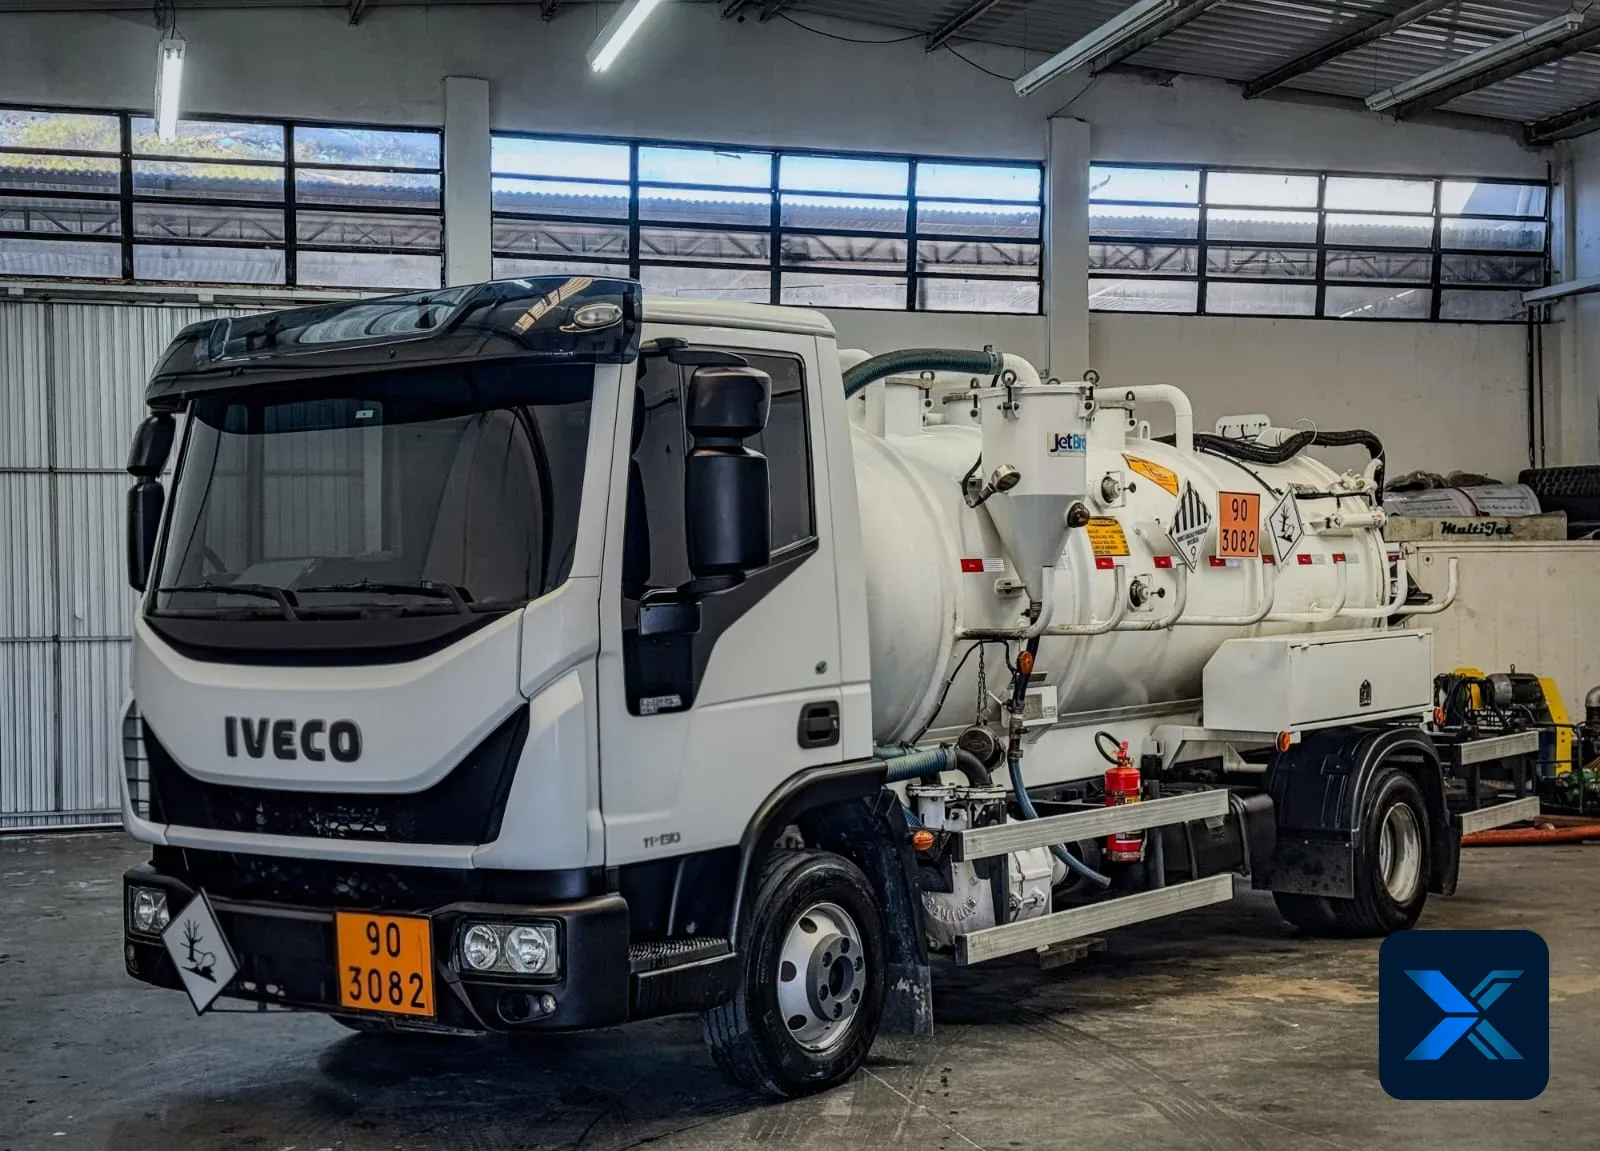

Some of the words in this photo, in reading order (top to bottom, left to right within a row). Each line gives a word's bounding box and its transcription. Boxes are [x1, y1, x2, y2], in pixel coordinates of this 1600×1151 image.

[1232, 498, 1248, 522] 90
[1222, 528, 1255, 552] 3082
[1440, 521, 1513, 537] MultiJet
[225, 716, 363, 763] IVECO
[366, 921, 401, 958] 90
[348, 966, 425, 1009] 3082
